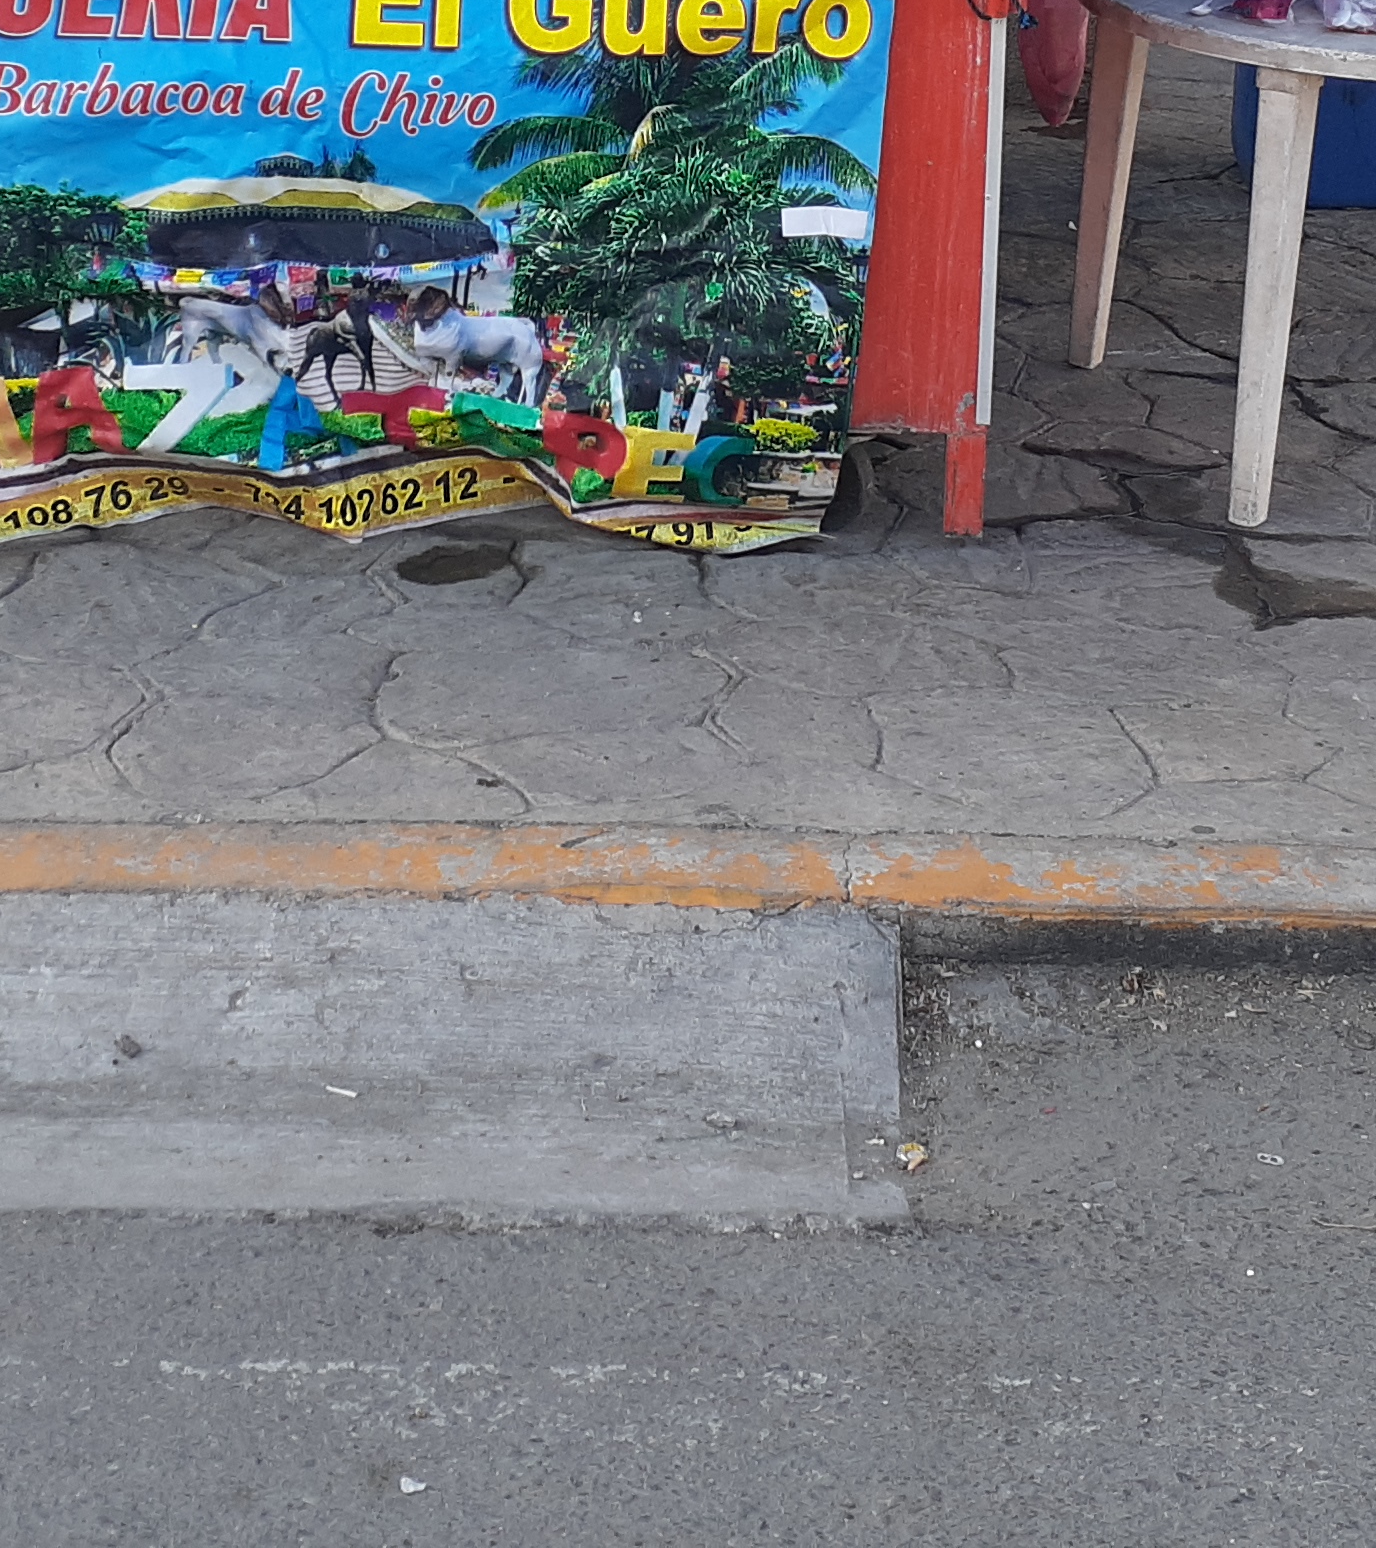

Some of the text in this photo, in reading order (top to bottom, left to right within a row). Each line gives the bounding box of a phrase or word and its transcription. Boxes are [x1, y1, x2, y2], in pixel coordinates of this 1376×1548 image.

[258, 68, 324, 120] de
[340, 71, 497, 138] Chivo
[3, 497, 74, 531] 108
[83, 479, 133, 520] 76
[143, 475, 190, 502] 29
[434, 467, 479, 504] 12
